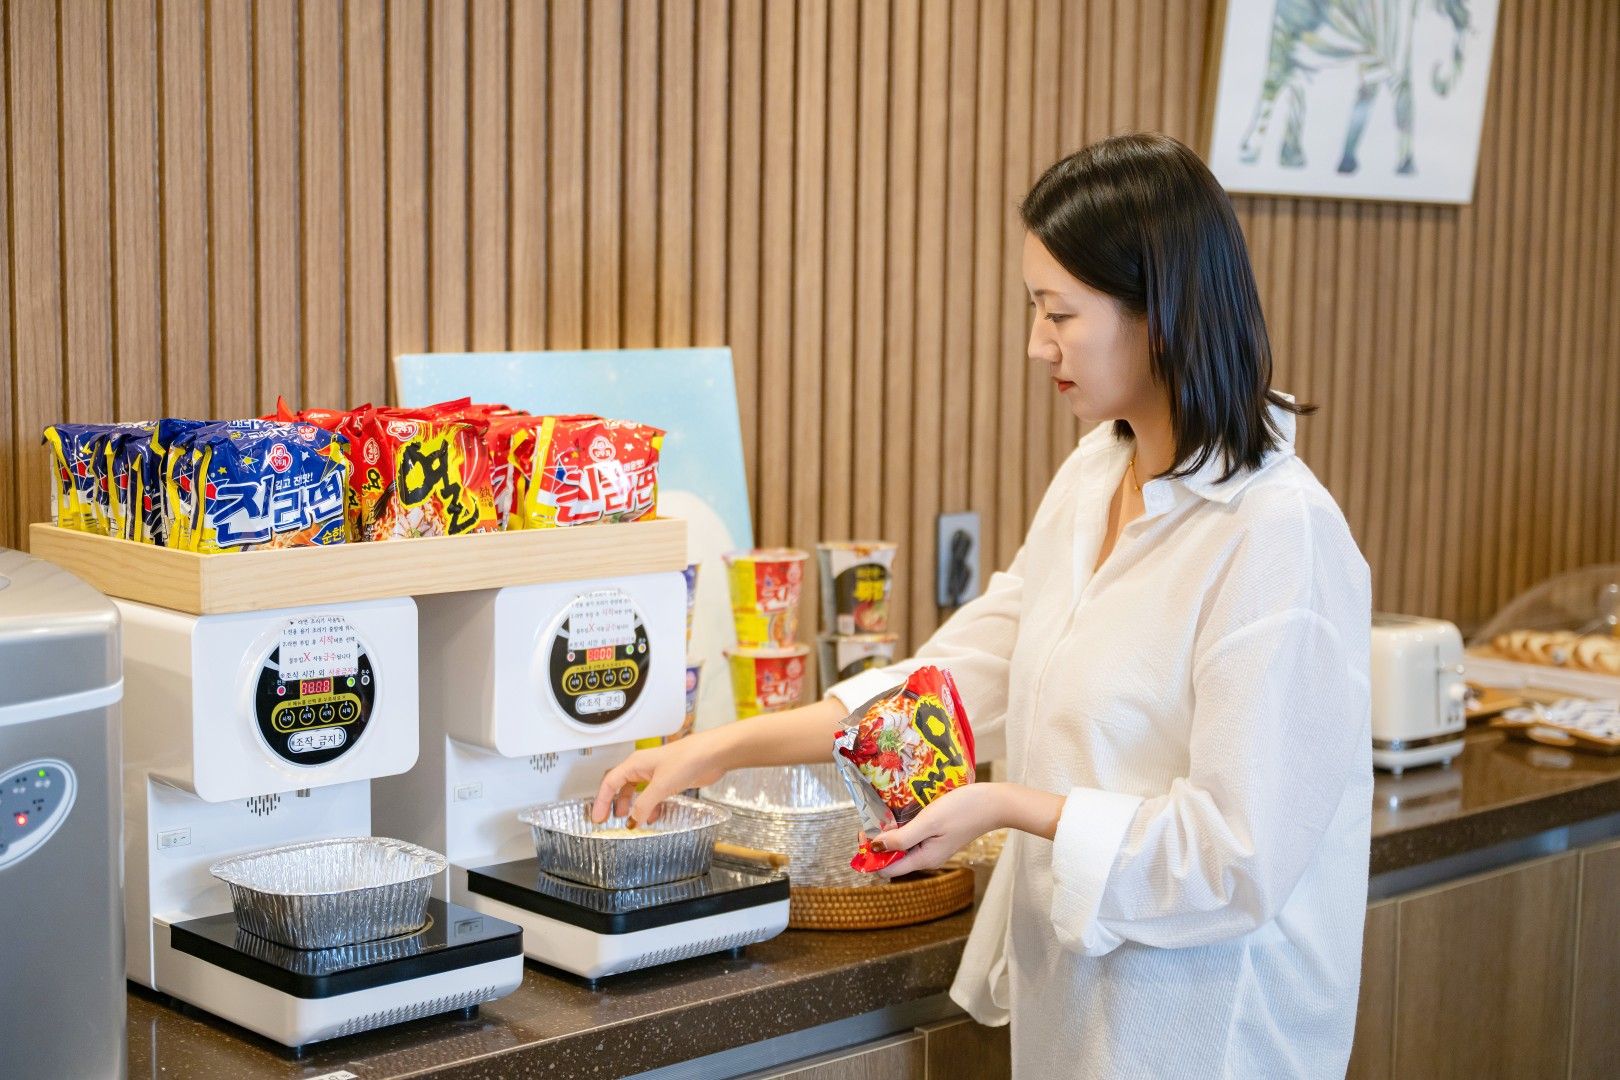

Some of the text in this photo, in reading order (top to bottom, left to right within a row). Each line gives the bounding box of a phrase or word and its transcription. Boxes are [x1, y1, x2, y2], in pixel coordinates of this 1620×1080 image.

[212, 469, 345, 548] 진라면
[398, 438, 480, 535] 열
[555, 462, 659, 527] 진라면
[321, 524, 345, 545] 순한
[296, 735, 336, 746] 조작 금지
